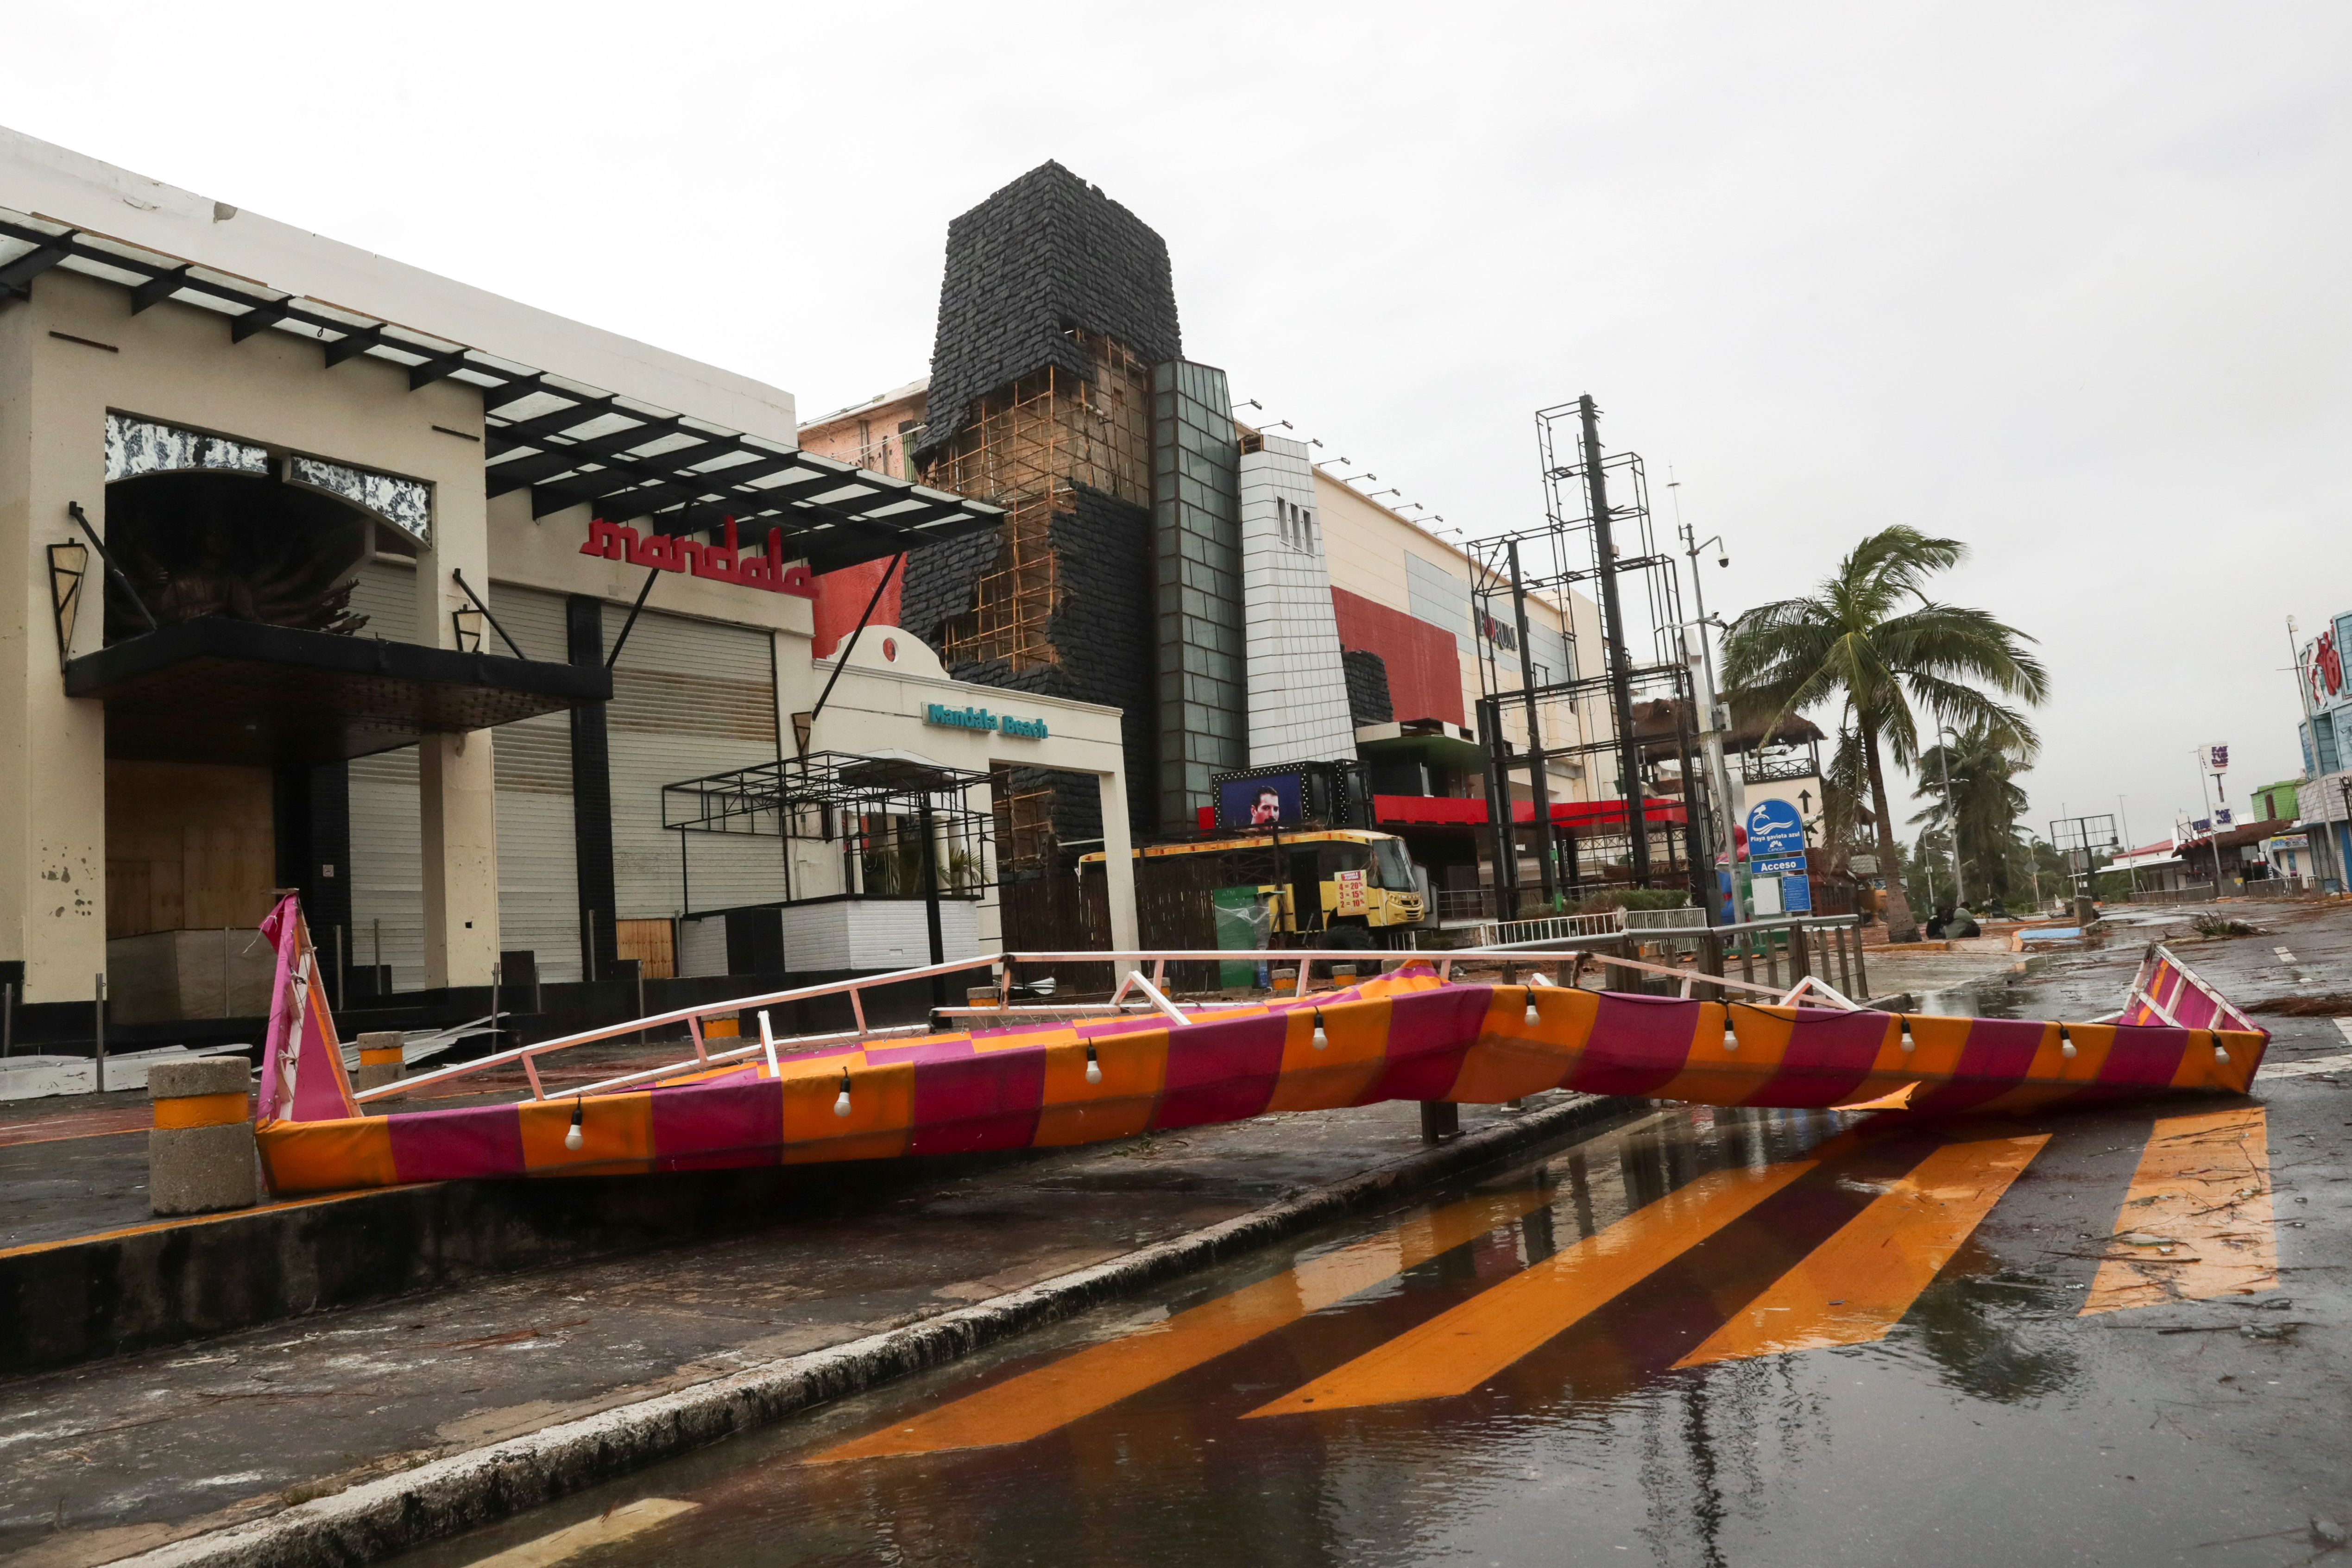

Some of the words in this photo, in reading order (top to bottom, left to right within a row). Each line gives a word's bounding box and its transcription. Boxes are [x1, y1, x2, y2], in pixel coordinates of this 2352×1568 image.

[579, 515, 820, 601] mandala
[1475, 606, 1518, 651] FORUM
[927, 704, 999, 730] Mandala
[1002, 716, 1048, 739] Beach
[1761, 861, 1797, 872] Acceso
